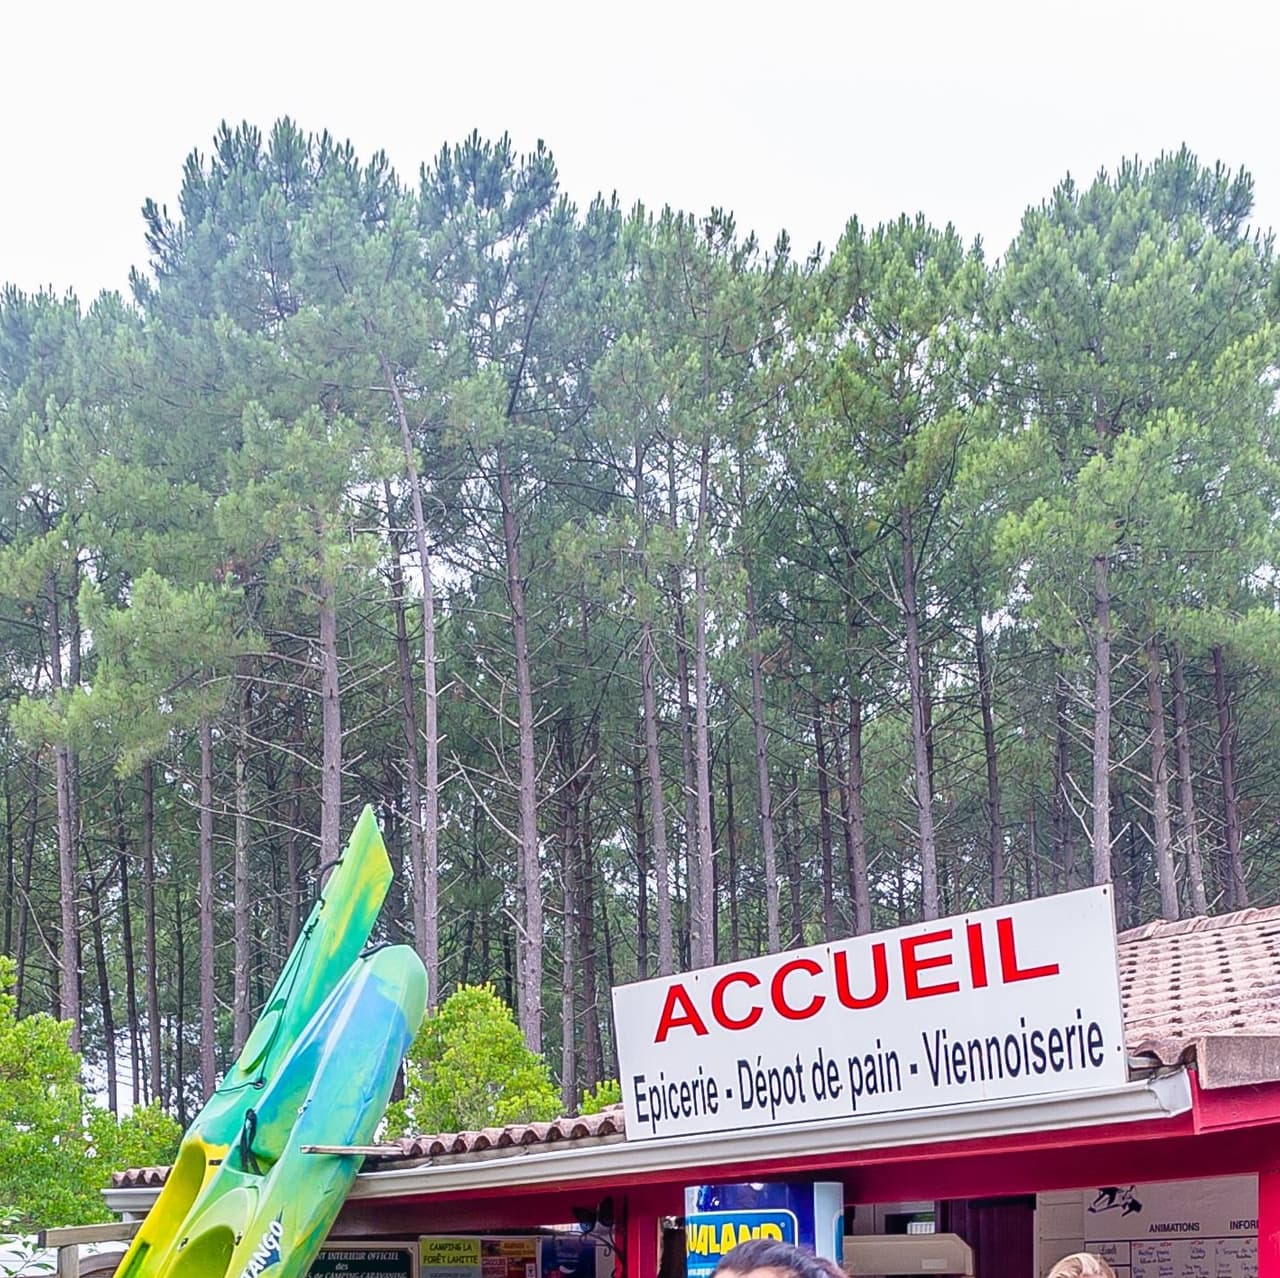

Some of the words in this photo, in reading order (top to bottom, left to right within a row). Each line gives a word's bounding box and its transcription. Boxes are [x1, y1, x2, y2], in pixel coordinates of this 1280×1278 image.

[654, 917, 1060, 1043] ACCUEIL
[633, 1066, 719, 1134] Epicerie
[738, 1055, 804, 1121] Dépot
[810, 1047, 842, 1100] de
[848, 1039, 901, 1111] pain
[922, 1008, 1105, 1087] Viennoiserie
[1149, 1222, 1200, 1234] ANIMATIONS
[1230, 1220, 1259, 1231] INFOR
[429, 1242, 462, 1252] CAMPING
[463, 1242, 473, 1252] LA
[423, 1252, 446, 1264] FORÊT
[335, 1262, 349, 1271] des
